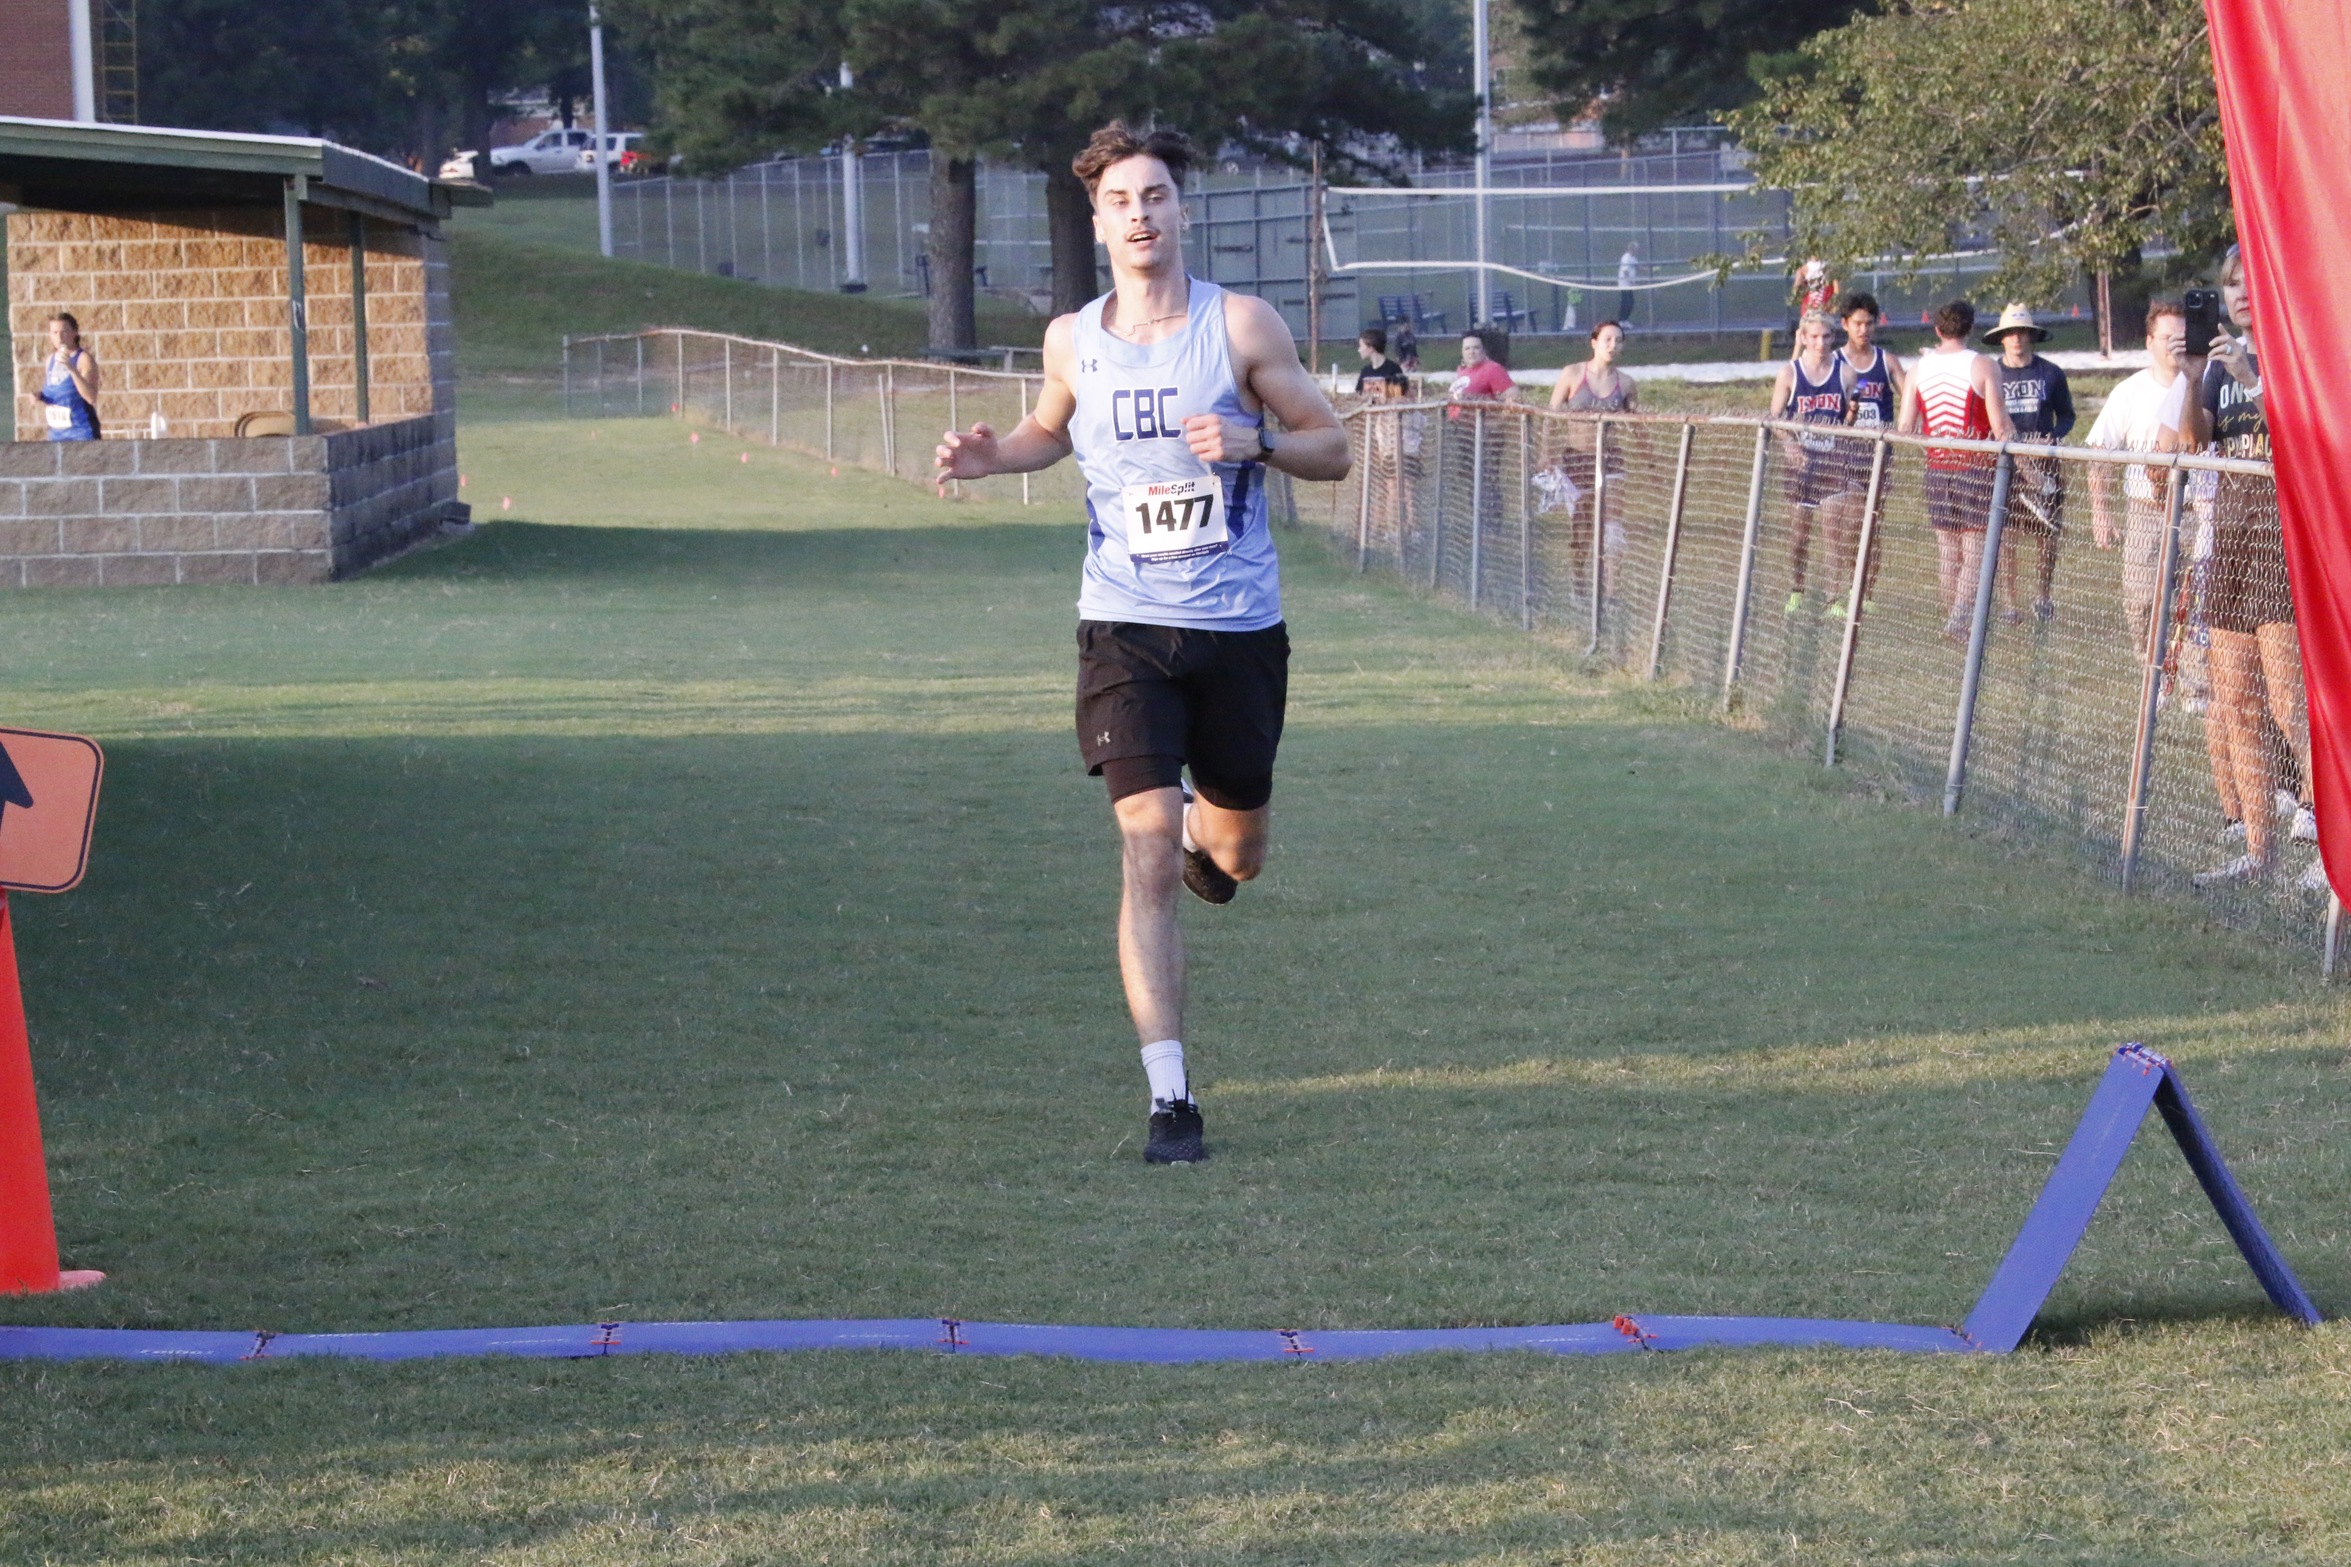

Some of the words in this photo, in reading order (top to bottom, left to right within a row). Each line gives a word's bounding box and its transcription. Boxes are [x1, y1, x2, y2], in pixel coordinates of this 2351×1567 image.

[2002, 379, 2047, 400] YON
[2220, 381, 2253, 409] ON
[1111, 386, 1182, 441] CBC
[1857, 409, 1877, 421] 503
[2238, 412, 2263, 432] my
[2241, 433, 2273, 458] PLAC
[1148, 481, 1196, 497] MileSplit
[1135, 493, 1214, 534] 1477
